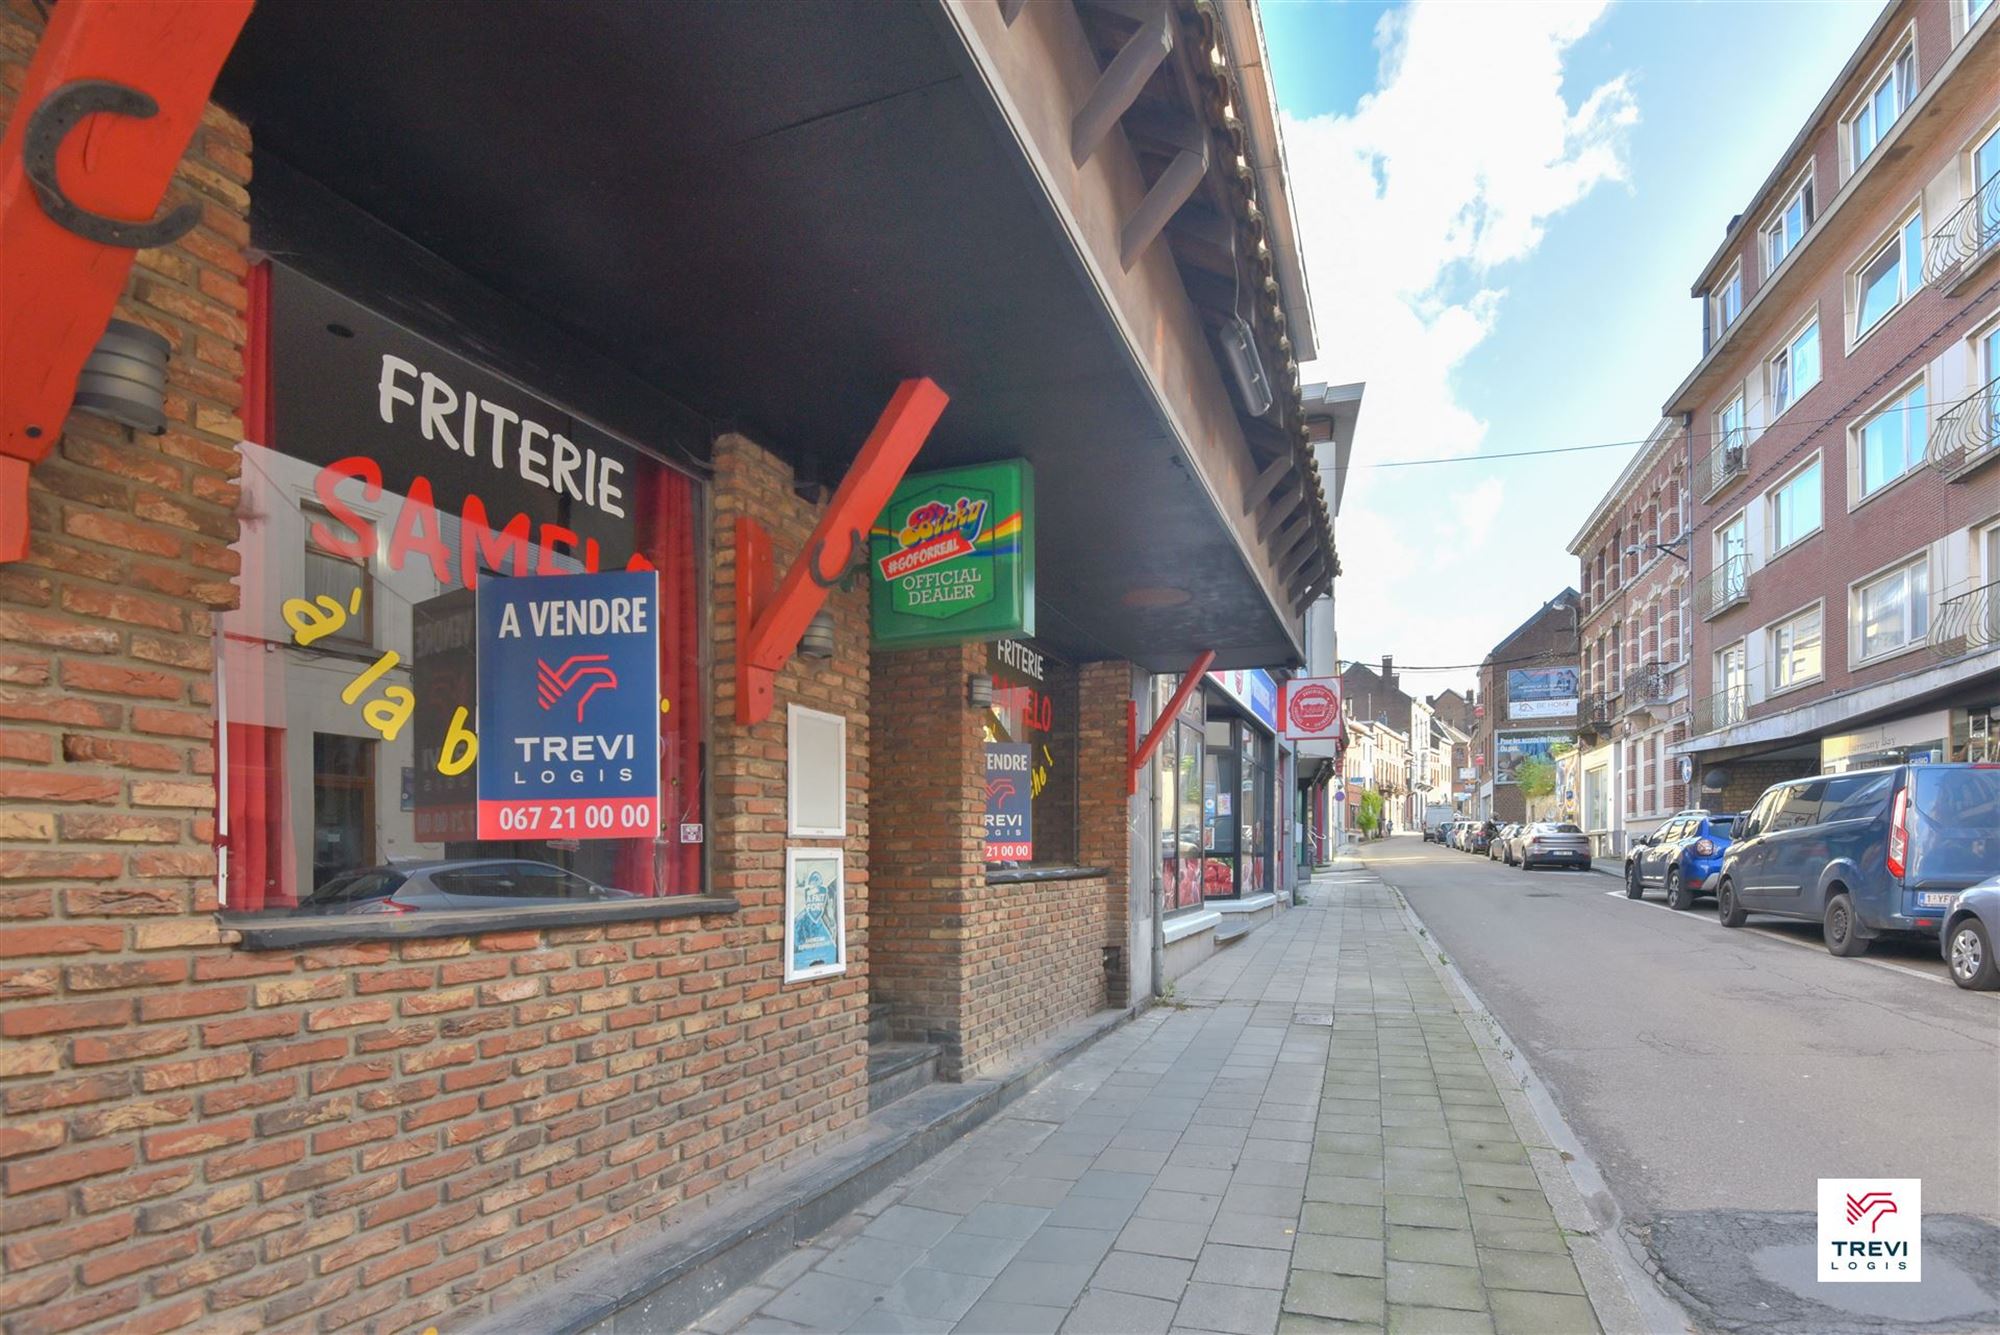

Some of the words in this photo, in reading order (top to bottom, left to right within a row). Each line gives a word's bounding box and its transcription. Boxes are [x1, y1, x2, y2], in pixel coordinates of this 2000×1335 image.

[379, 354, 625, 519] FRITERIE
[311, 456, 656, 590] SAME
[900, 497, 987, 546] Bicky
[888, 538, 960, 574] #GOFORREAL
[902, 568, 981, 591] OFFICIAL
[909, 586, 975, 606] DEALER
[498, 603, 521, 638] A
[529, 597, 648, 637] VENDRE
[997, 638, 1044, 681] FRITERIE
[514, 734, 634, 762] TREVI
[985, 753, 1028, 771] ENDRE
[514, 768, 633, 785] LOGIS
[500, 807, 542, 830] 067
[550, 806, 576, 830] 21
[585, 805, 614, 829] 00
[621, 804, 650, 828] 00
[984, 814, 1023, 826] REVI
[986, 846, 998, 857] 21
[1001, 845, 1014, 857] 00
[1016, 844, 1028, 856] 00
